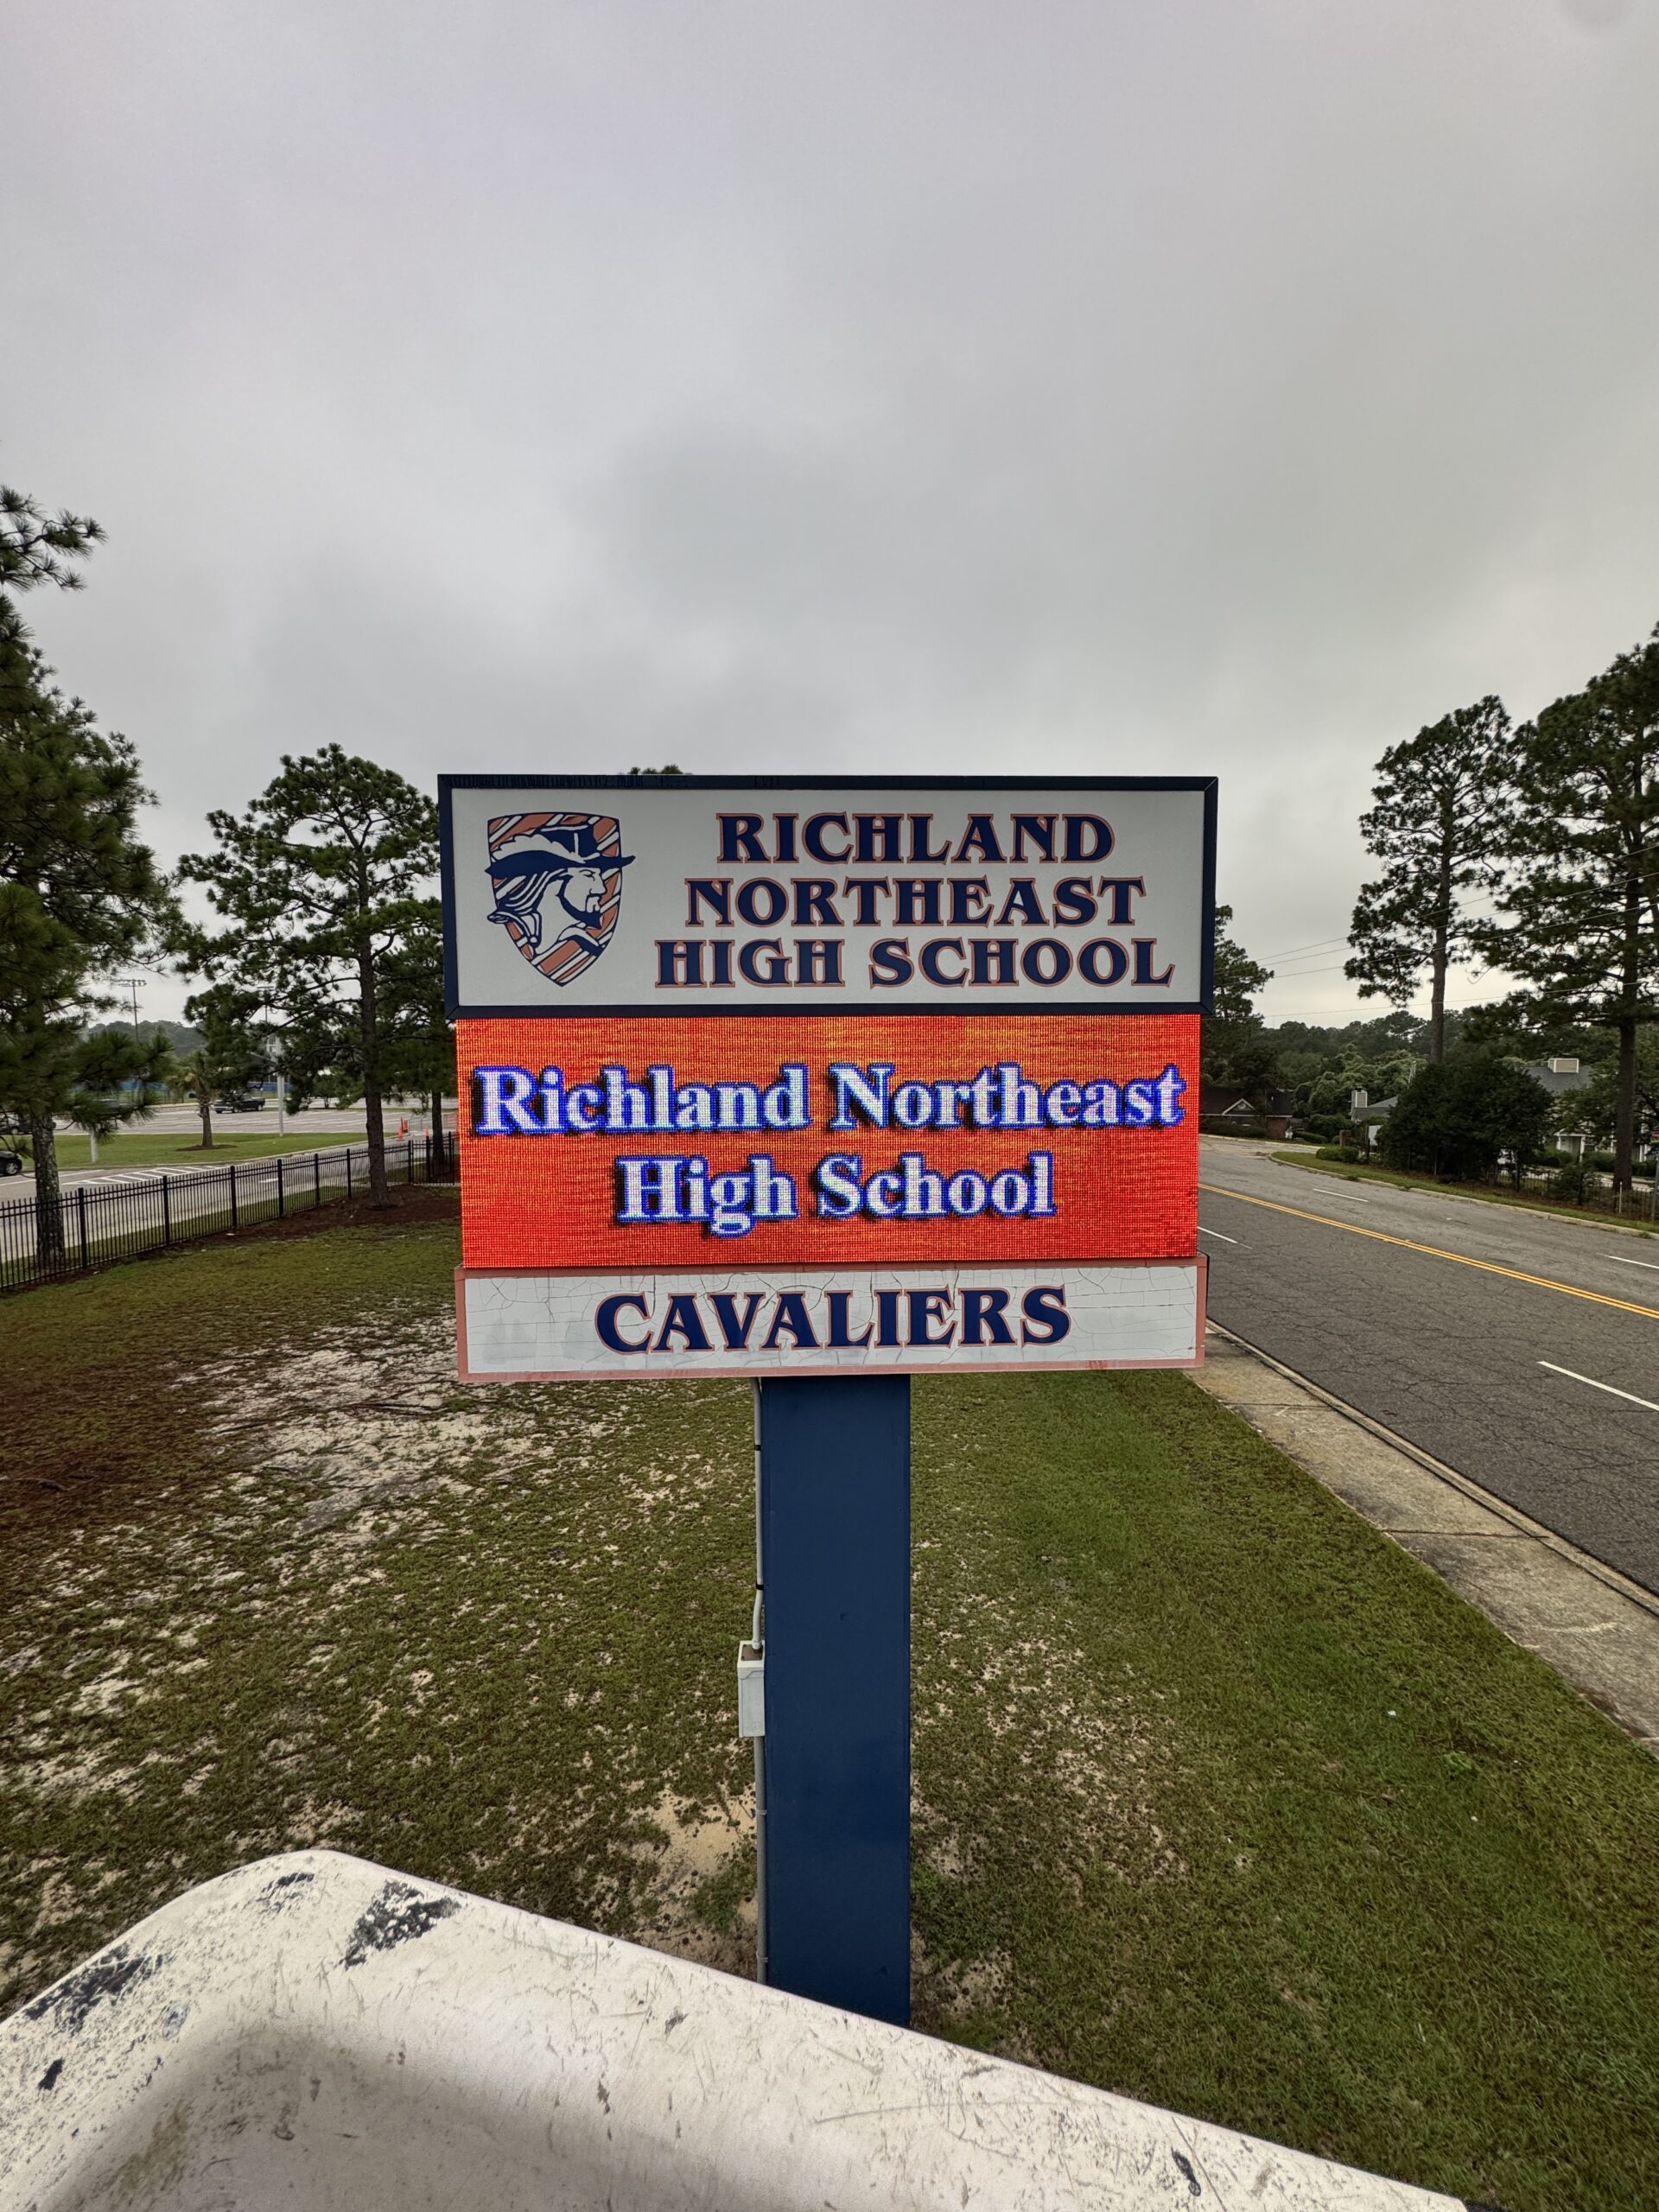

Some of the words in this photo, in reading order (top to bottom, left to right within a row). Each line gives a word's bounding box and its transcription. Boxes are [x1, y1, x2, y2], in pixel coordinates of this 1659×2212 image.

[716, 811, 1116, 863] RICHLAND
[684, 876, 1147, 929] NORTHEAST
[654, 938, 845, 988] HIGH
[868, 937, 1176, 989] SCHOOL
[474, 1063, 811, 1136] Richland
[827, 1063, 1186, 1131] Northeast
[614, 1154, 798, 1238] High
[813, 1152, 1057, 1221] School
[594, 1285, 1072, 1355] CAVALIERS
